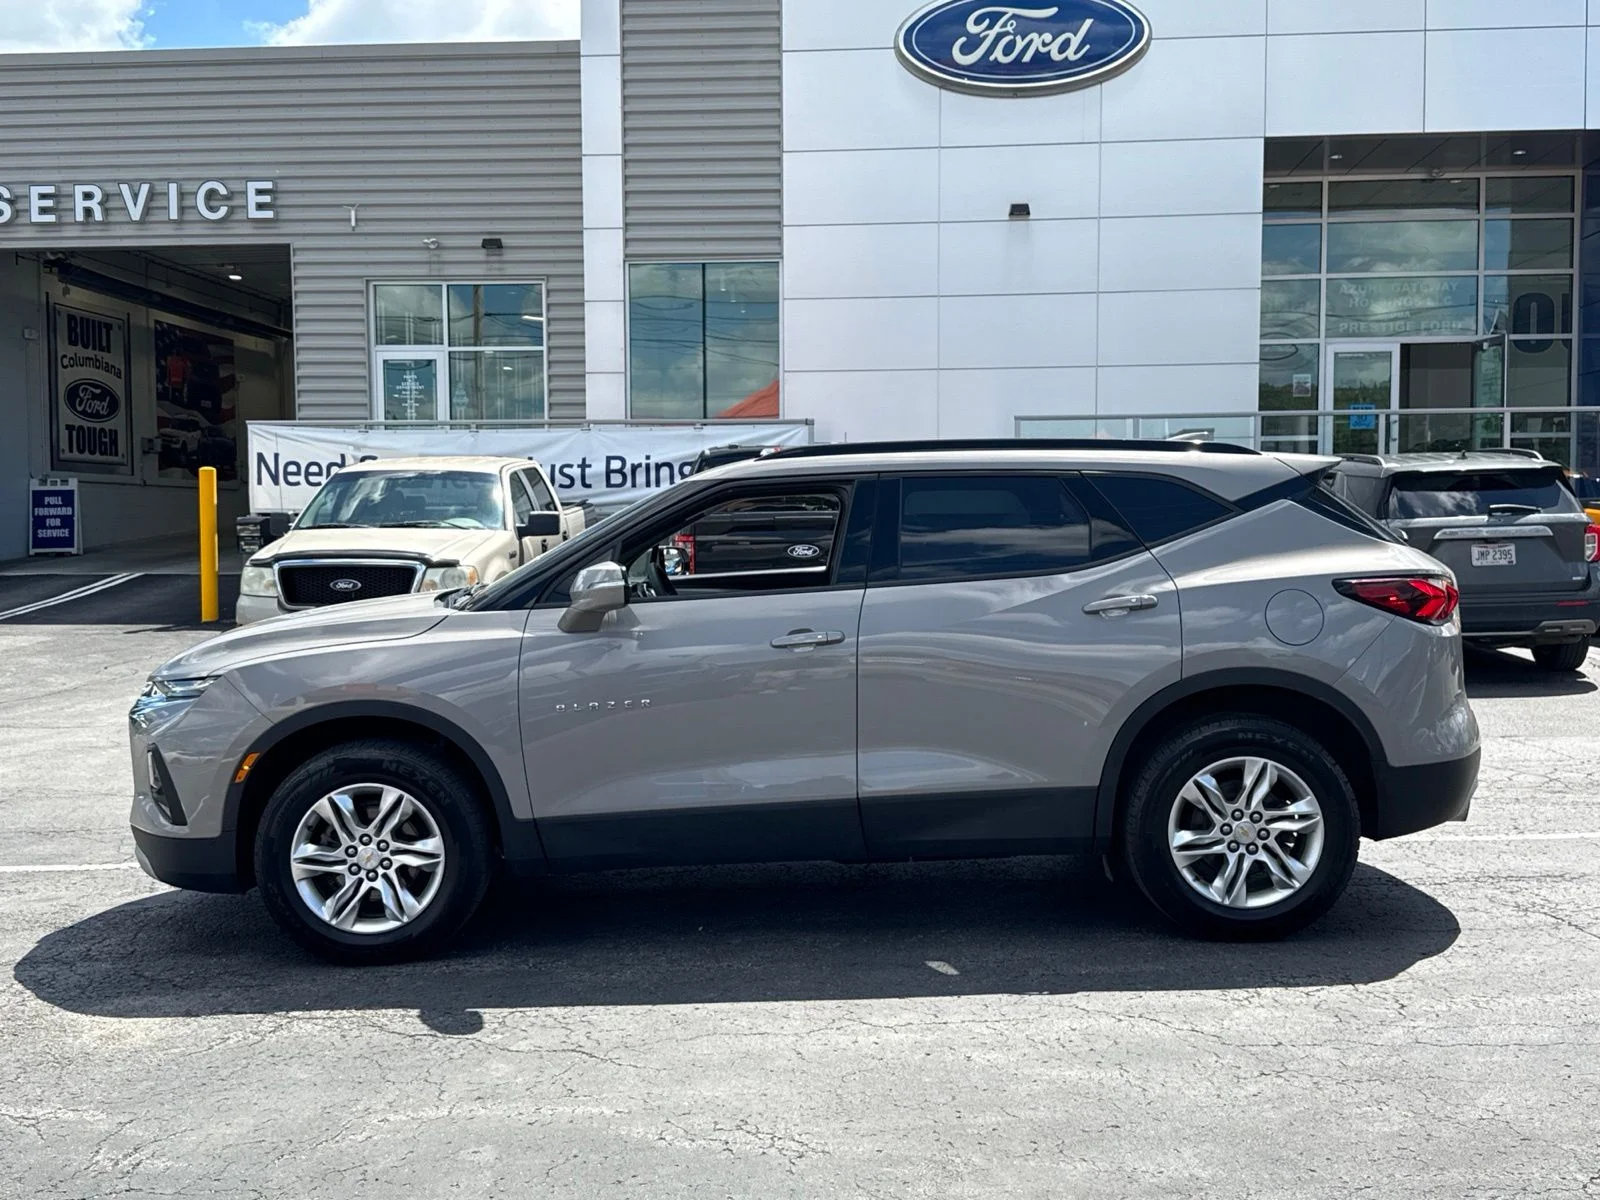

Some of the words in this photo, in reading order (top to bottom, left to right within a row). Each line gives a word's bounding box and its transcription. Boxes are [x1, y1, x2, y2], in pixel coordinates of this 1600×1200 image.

[952, 6, 1094, 66] Ford
[1349, 297, 1421, 307] HOINGS
[66, 313, 113, 354] BUILT
[1339, 322, 1415, 333] PRESTIGE
[60, 352, 123, 380] Columbiana
[75, 383, 111, 416] Ford
[64, 423, 119, 457] TOUGH
[256, 452, 346, 487] Need
[538, 456, 593, 489] ust
[605, 454, 695, 489] Bring
[44, 496, 63, 505] PULL
[34, 507, 73, 516] FORWARD
[46, 518, 61, 527] FOR
[37, 528, 70, 538] SERVICE
[1492, 548, 1513, 561] 2395
[555, 699, 650, 712] BLAZER
[382, 760, 451, 807] NEXEN
